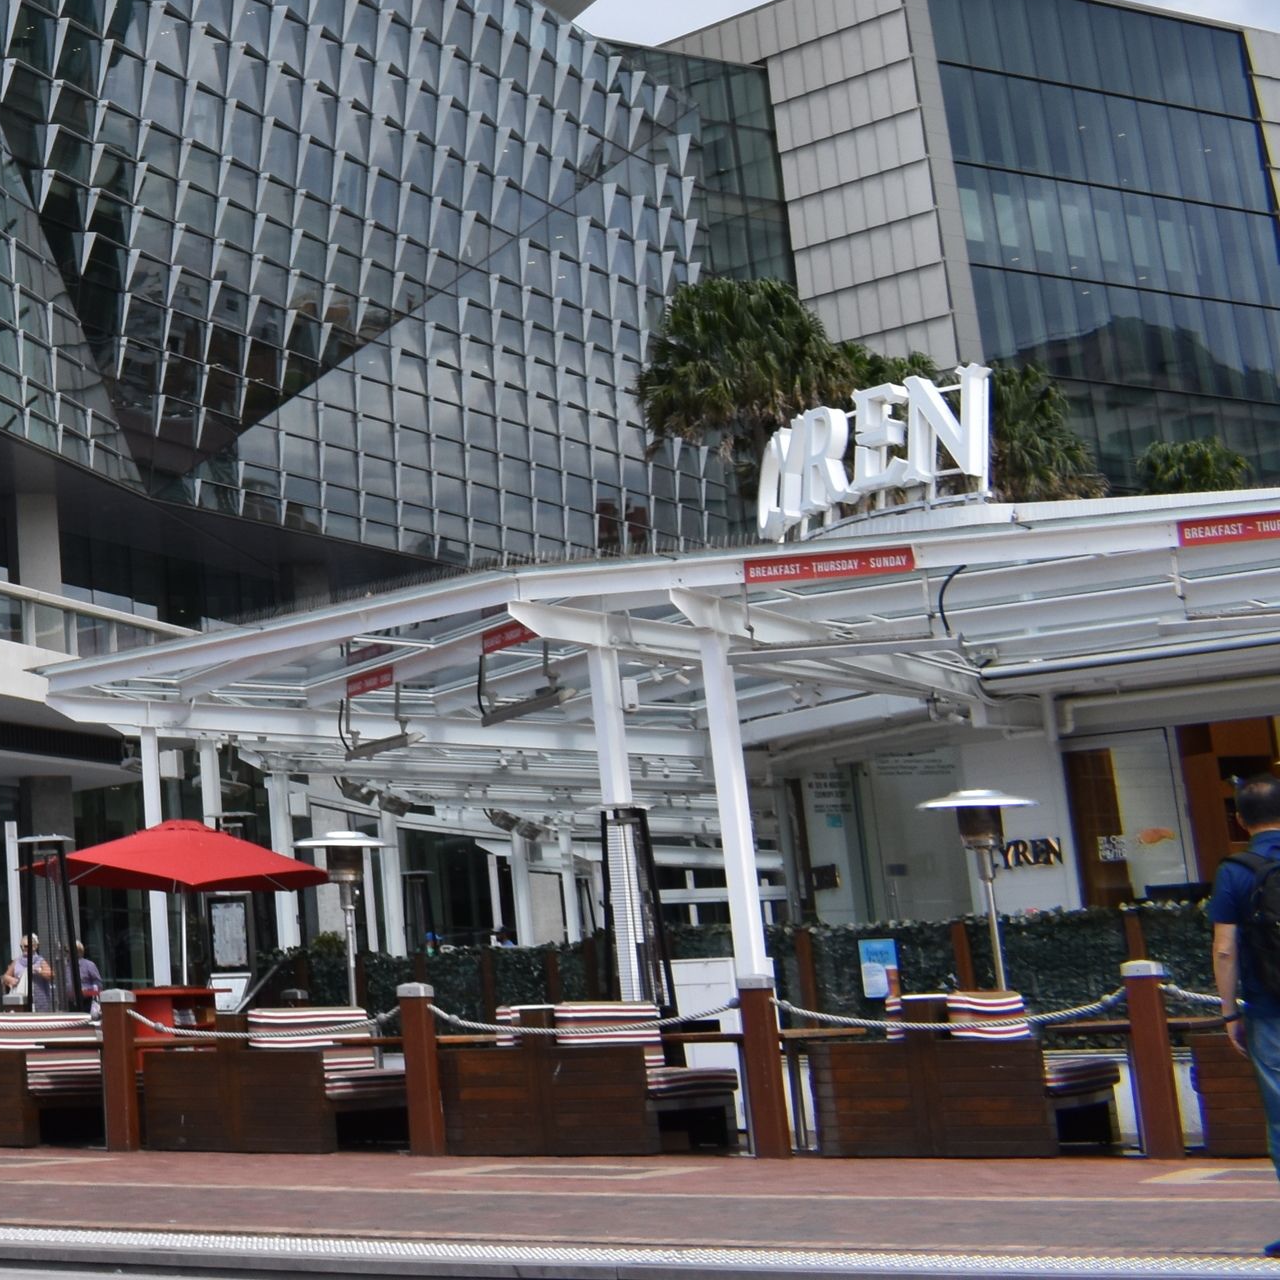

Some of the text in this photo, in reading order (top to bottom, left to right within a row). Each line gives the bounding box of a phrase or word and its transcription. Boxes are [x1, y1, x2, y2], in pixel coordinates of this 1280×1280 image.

[1183, 523, 1243, 539] BREAKFAST
[749, 555, 907, 578] BREAKFAST THURSDAY SUNDAY
[996, 834, 1064, 870] YREN
